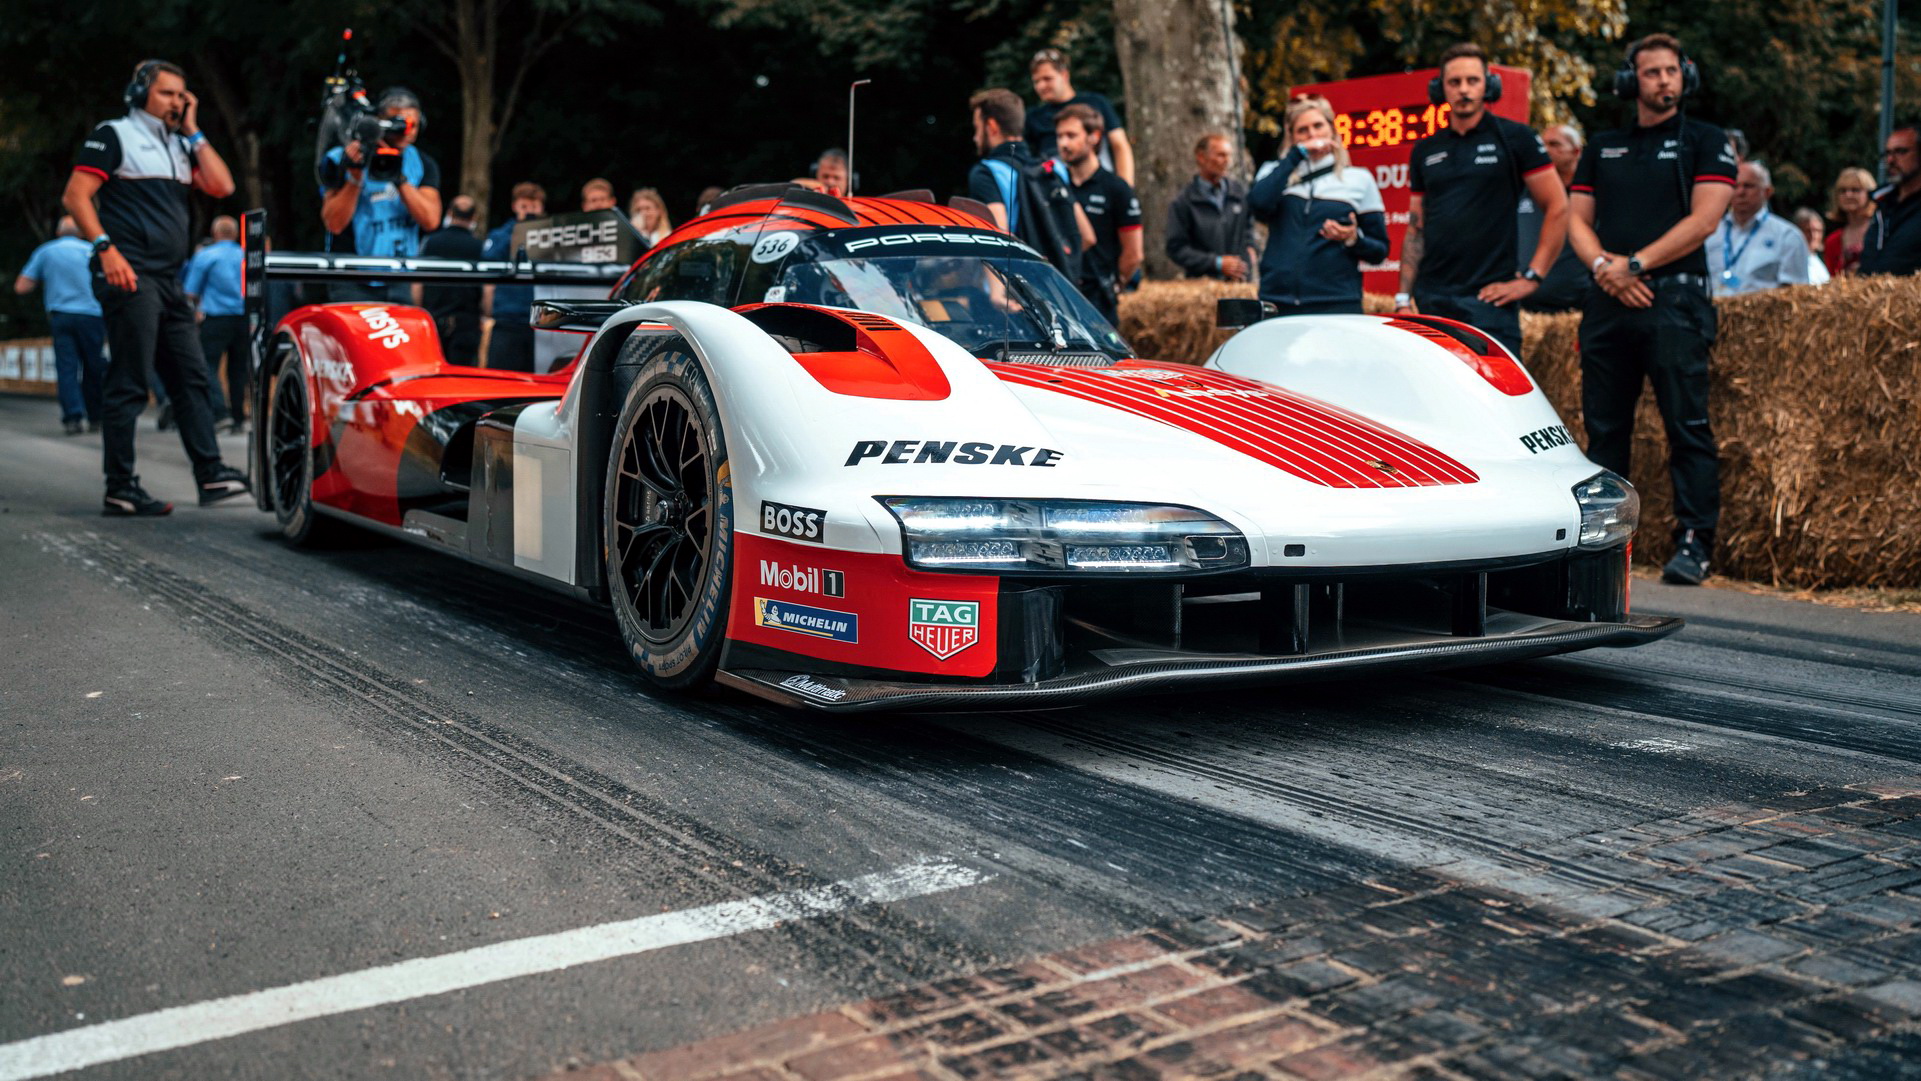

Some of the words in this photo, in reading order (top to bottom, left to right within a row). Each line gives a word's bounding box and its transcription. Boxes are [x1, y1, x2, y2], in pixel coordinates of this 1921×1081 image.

[1376, 163, 1412, 190] DU
[526, 220, 618, 250] PORSCHE
[756, 237, 789, 255] 536
[581, 244, 618, 263] 963
[844, 440, 1064, 467] PENSKE
[764, 506, 818, 538] BOSS
[695, 513, 729, 640] MICHELIN
[760, 559, 819, 594] Mobil
[782, 612, 848, 633] MICHELIN
[916, 604, 972, 623] TAG
[914, 626, 973, 655] HEUER
